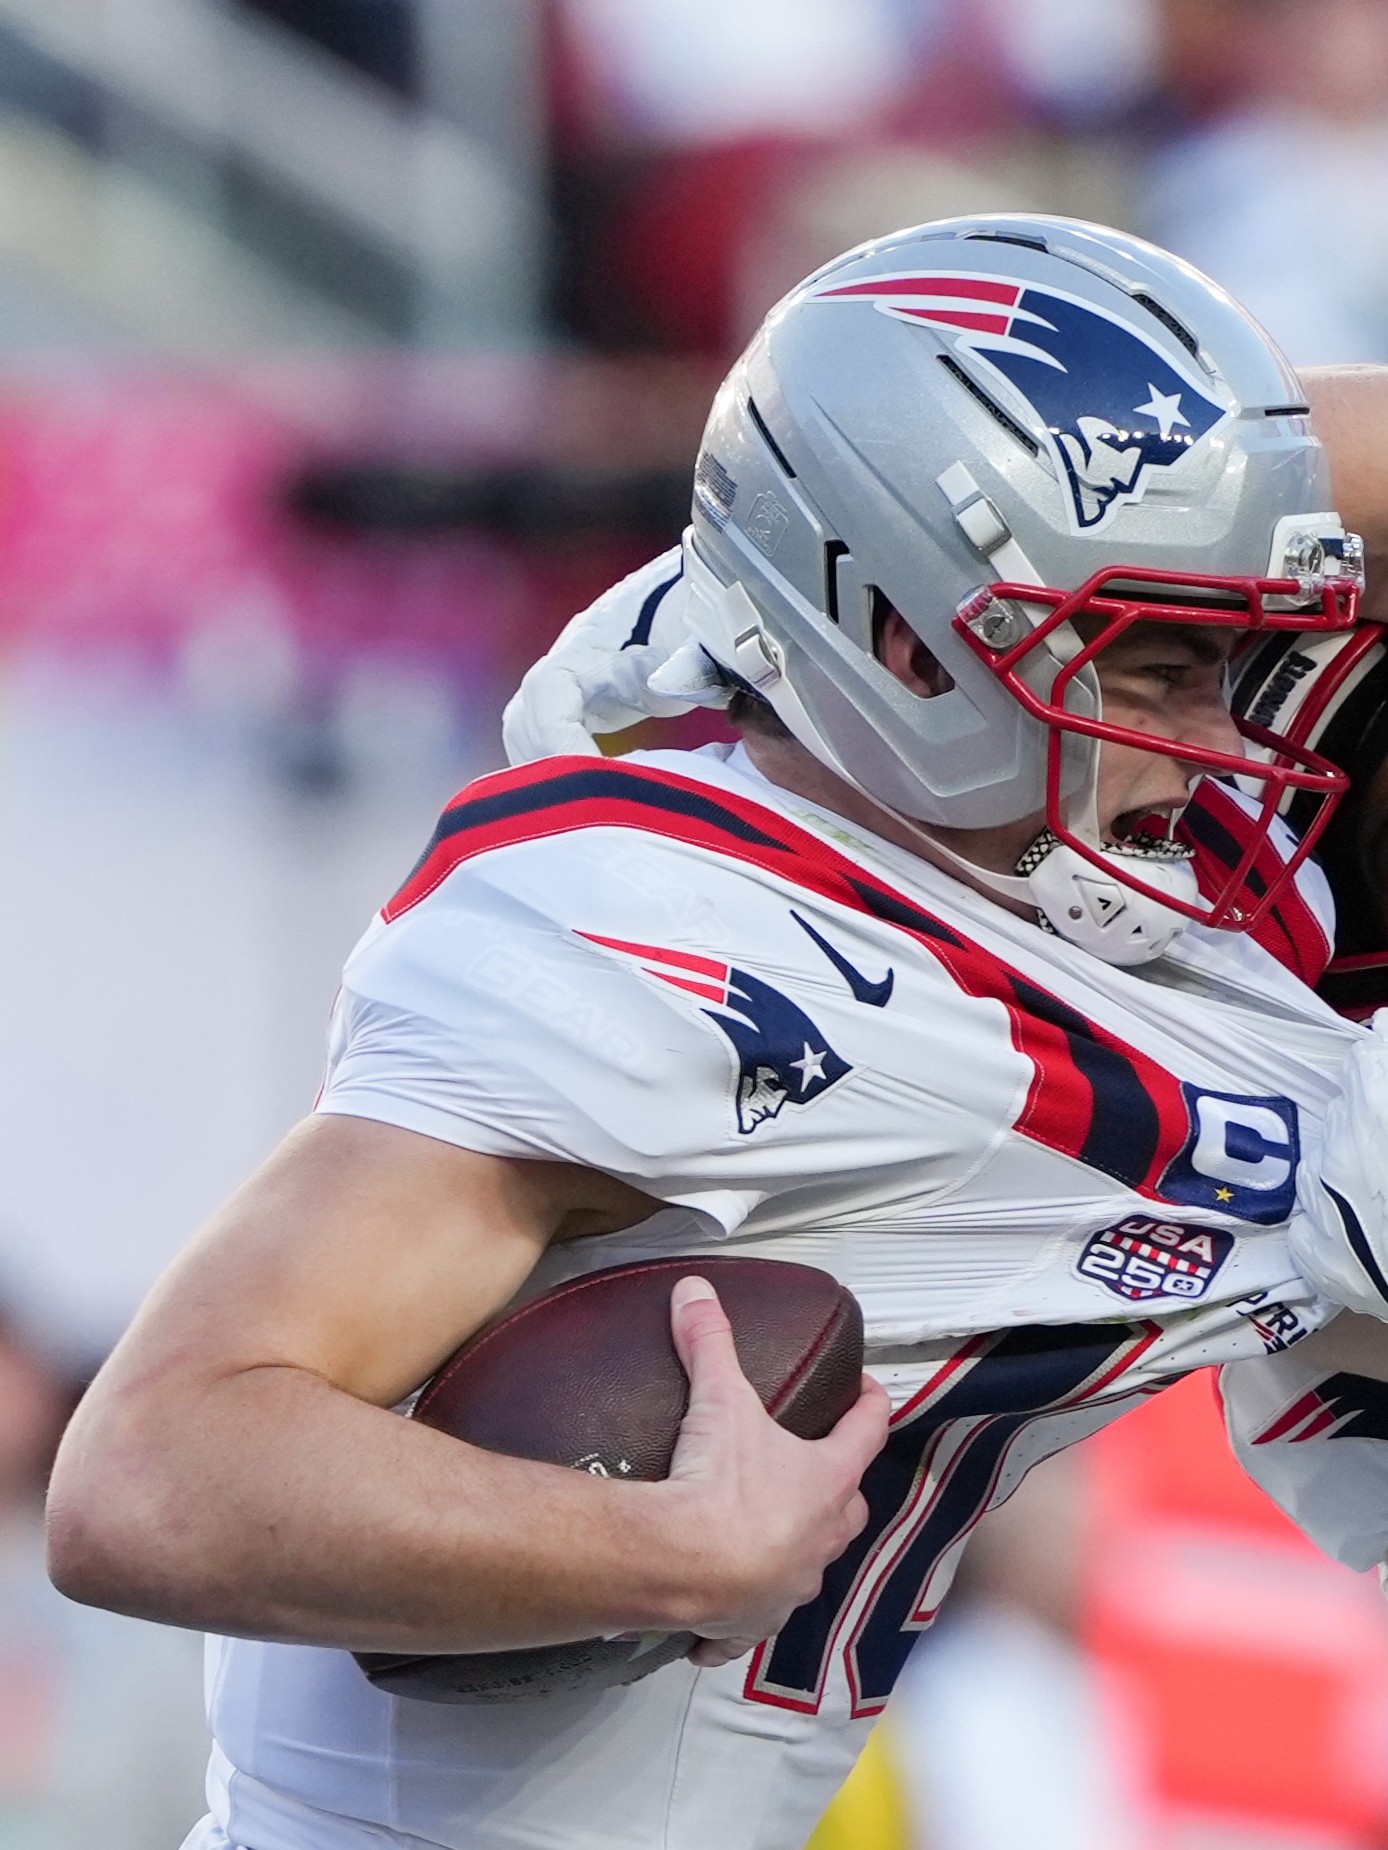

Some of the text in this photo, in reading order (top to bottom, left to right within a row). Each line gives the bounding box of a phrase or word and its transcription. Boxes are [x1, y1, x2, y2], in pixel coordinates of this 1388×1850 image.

[1191, 1095, 1291, 1192] C
[1118, 1221, 1214, 1264] USA
[1081, 1243, 1205, 1297] 250
